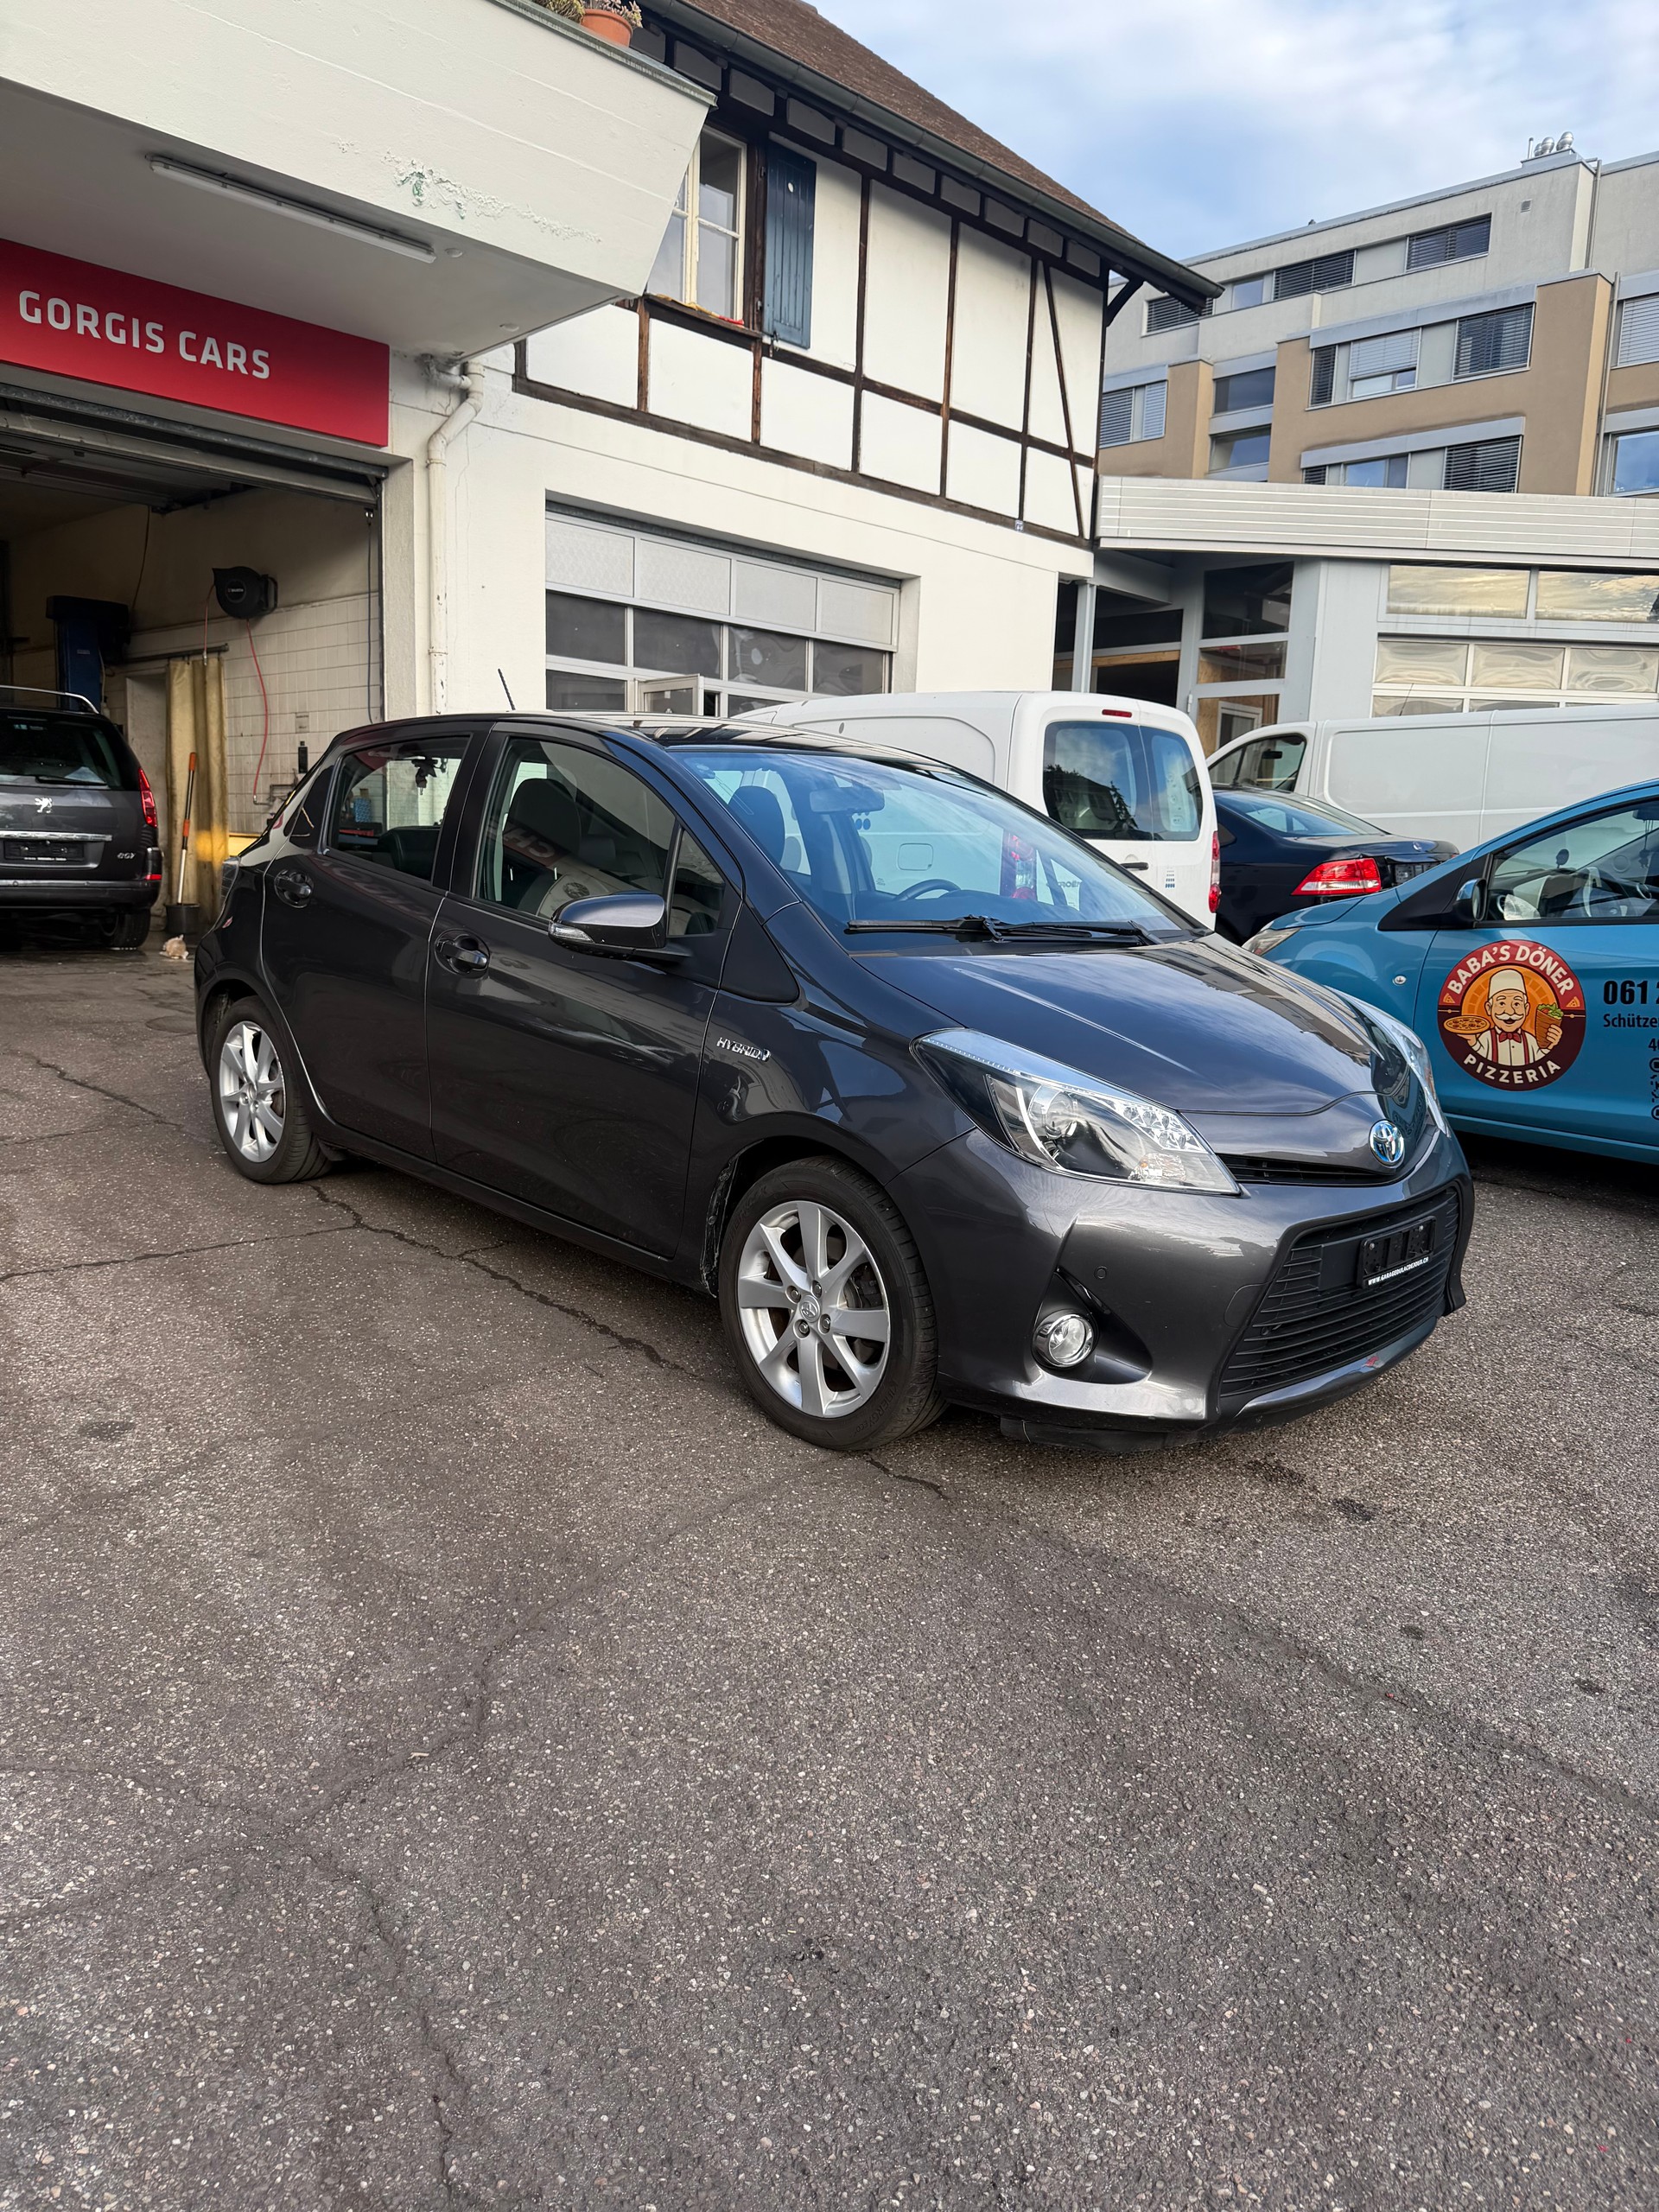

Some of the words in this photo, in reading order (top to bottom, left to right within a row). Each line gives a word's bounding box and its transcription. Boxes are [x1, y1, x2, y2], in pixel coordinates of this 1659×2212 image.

[19, 290, 165, 353] GORGIS
[179, 331, 270, 379] CARS
[1447, 944, 1511, 995] BABA'S
[1515, 944, 1575, 995] DÖNER
[1603, 980, 1648, 1005] 061
[1603, 1013, 1659, 1028] Schütze
[1463, 1053, 1561, 1084] PIZZERIA
